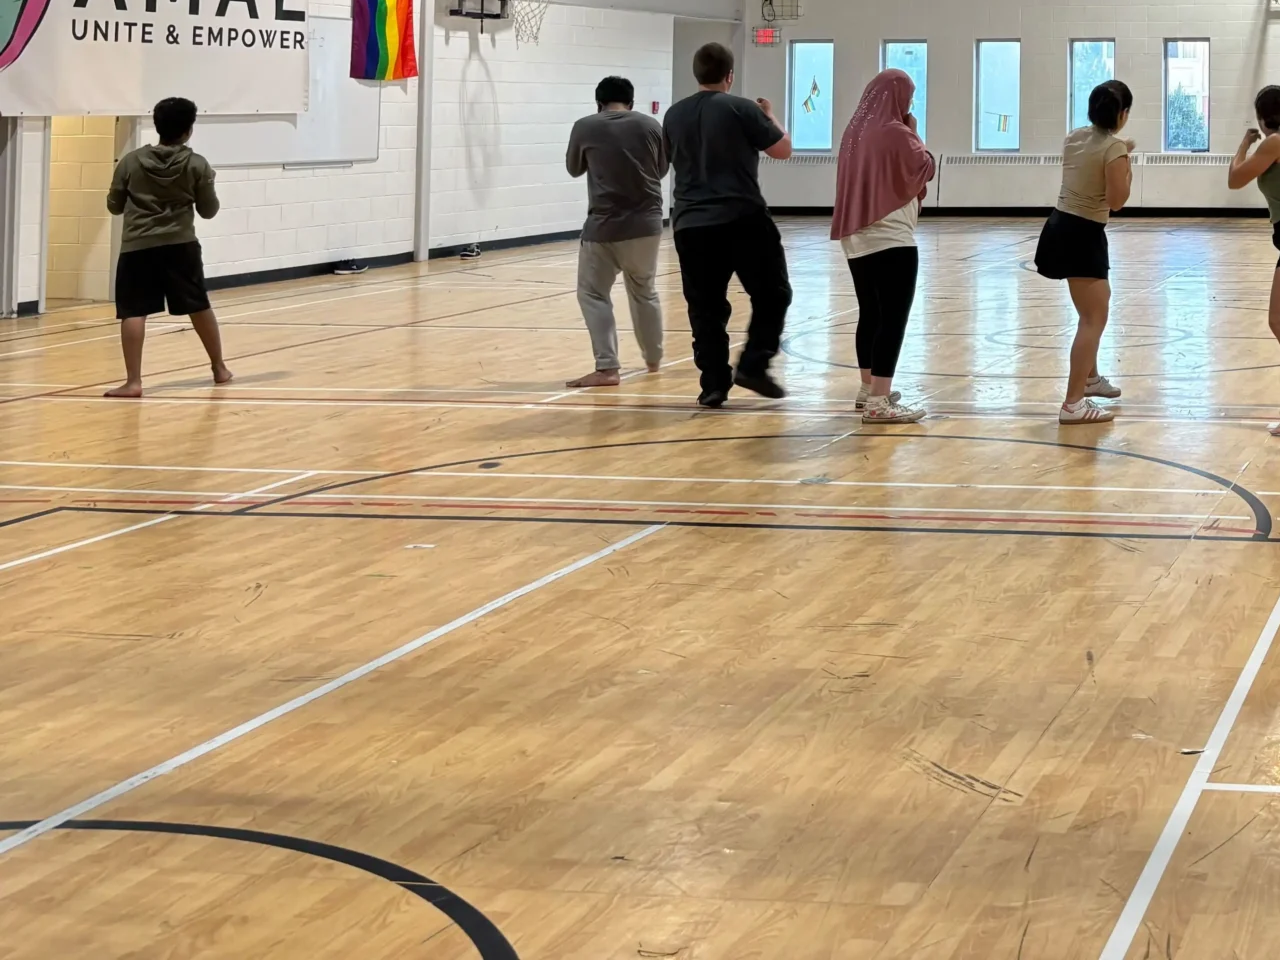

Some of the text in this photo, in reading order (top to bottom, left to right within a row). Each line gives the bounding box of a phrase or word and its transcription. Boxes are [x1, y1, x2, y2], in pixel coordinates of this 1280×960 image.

[71, 18, 306, 50] UNITE & EMPOWER
